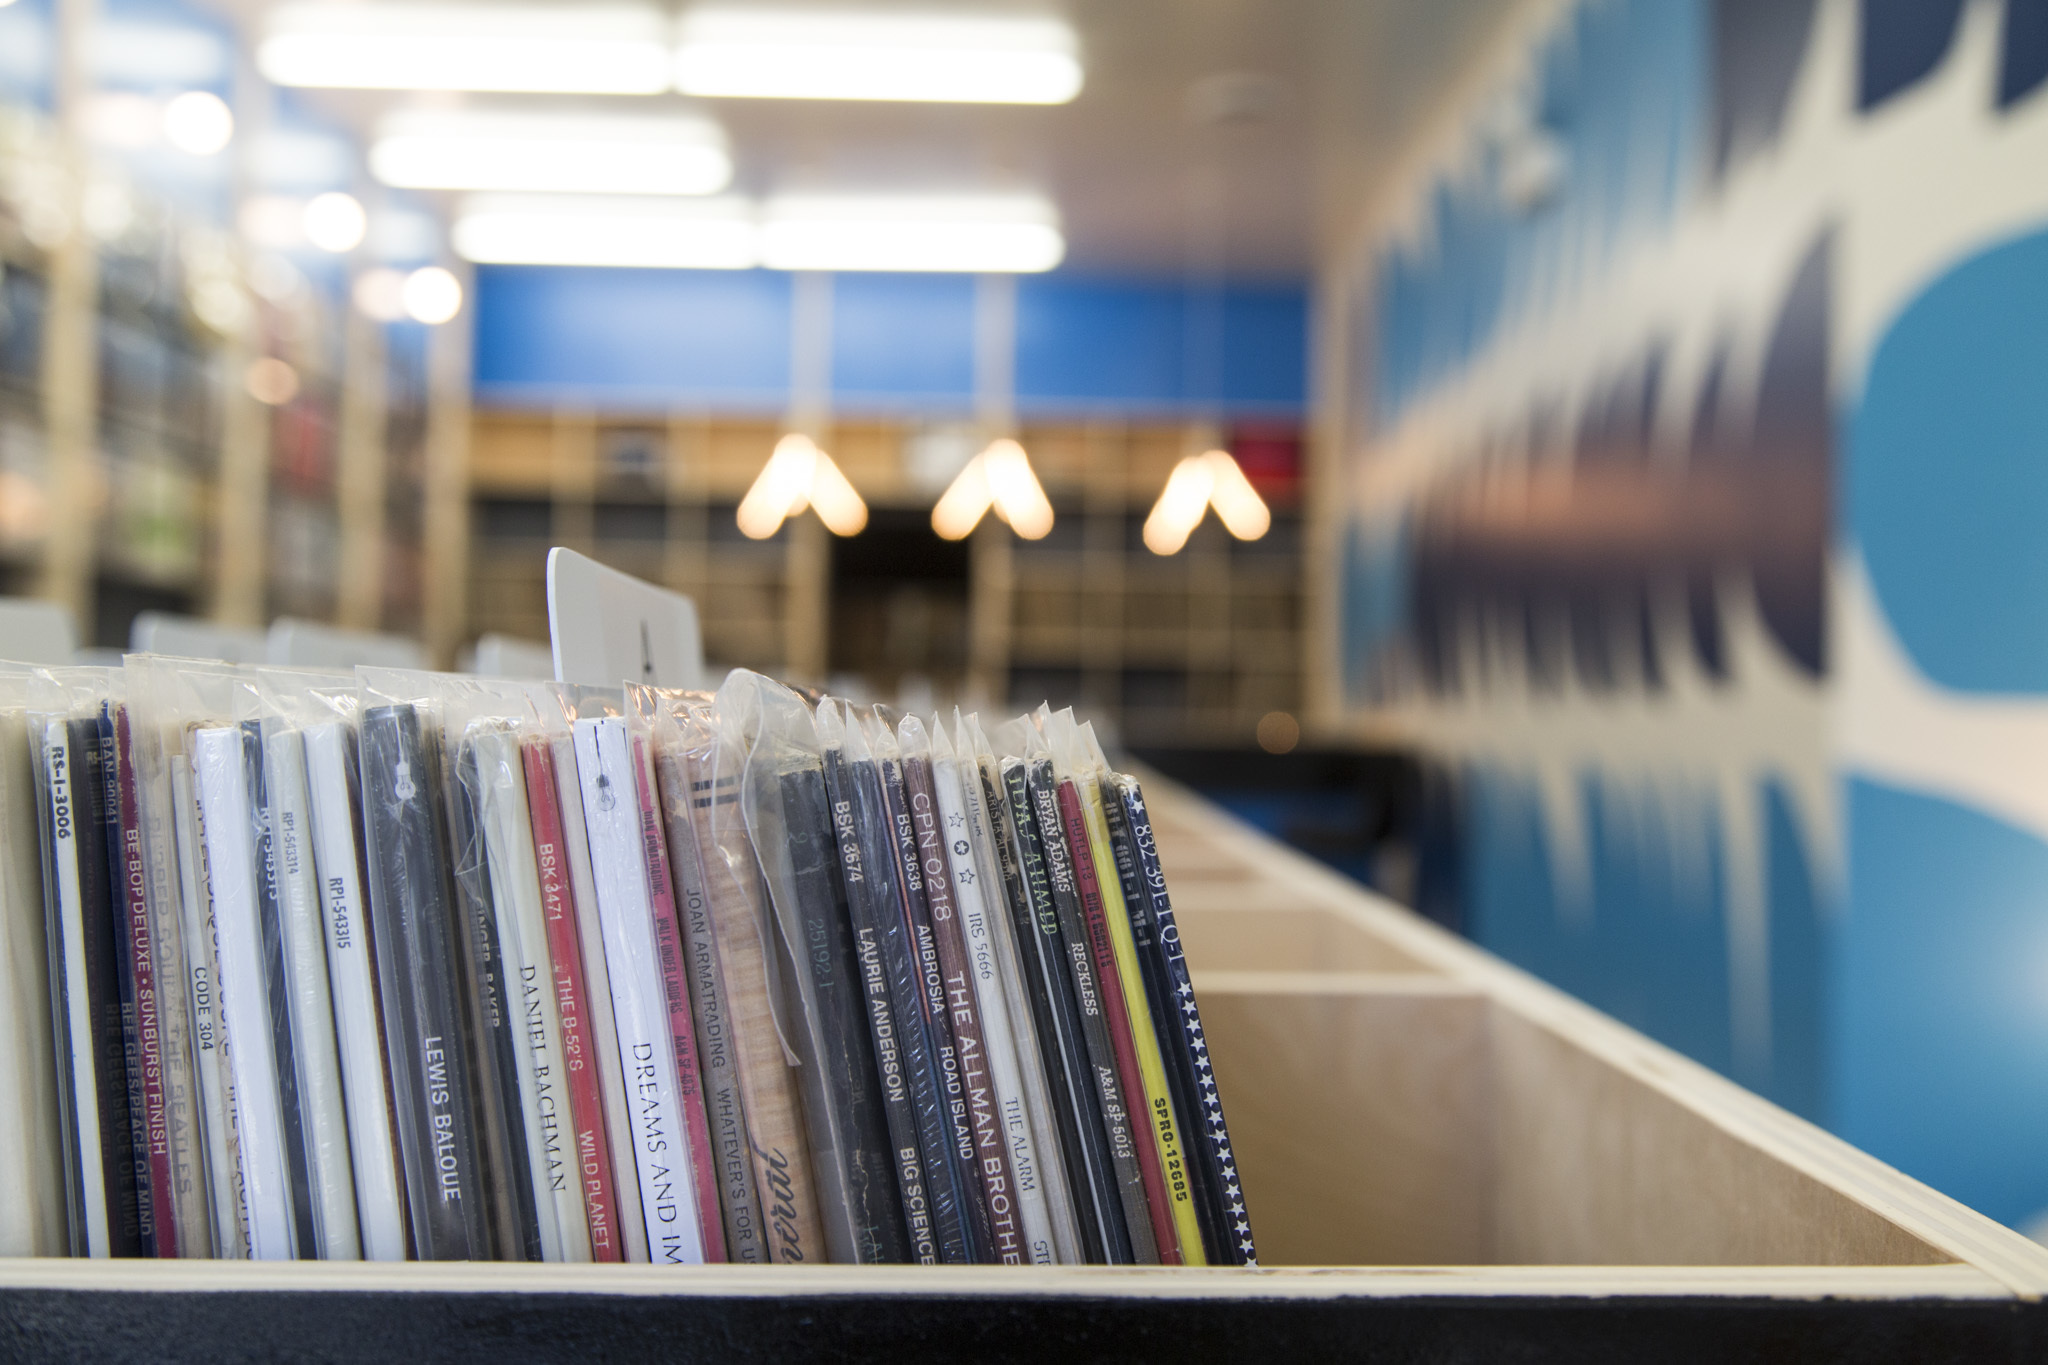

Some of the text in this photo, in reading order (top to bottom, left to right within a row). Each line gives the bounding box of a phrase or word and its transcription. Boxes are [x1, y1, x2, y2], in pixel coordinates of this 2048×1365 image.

[282, 812, 299, 874] RP1-543314
[913, 793, 938, 848] CPN
[329, 877, 351, 949] RP1-543315
[687, 889, 706, 933] JOAN
[968, 912, 985, 939] IRS
[1025, 852, 1058, 935] AHMED
[660, 943, 675, 972] UNDER
[976, 943, 995, 981] 5666
[1036, 789, 1059, 838] BRYAN
[1049, 841, 1071, 893] ADAMS
[1071, 942, 1098, 1016] RECKLESS
[1099, 1066, 1117, 1101] A&M
[126, 829, 167, 1156] BE-BOP DELUXE SUNBURST FINISH
[195, 967, 211, 1015] CODE
[663, 973, 683, 1014] LADDERS
[694, 942, 725, 1069] ARMATRADING
[897, 814, 974, 1160] BSK 3638 AMBROSIA ROAD ISLAND
[199, 1022, 214, 1051] 304
[539, 844, 609, 1249] BSK 3471 THE B-52'S WILD PLANET
[835, 801, 936, 1265] BSK 3674 LAURIE ANDERSON BIG SCIENCE
[520, 966, 566, 1192] DANIEL BACHMAN
[1005, 1097, 1023, 1131] THE
[425, 1036, 462, 1202] LEWIS BALOUE
[633, 1043, 668, 1153] DREAMS
[651, 1164, 678, 1223] AND
[717, 1088, 745, 1200] WHATEVER'S
[948, 970, 1021, 1266] THE ALLMAN BROTHE
[1154, 1097, 1188, 1202] SPRO-12685
[1013, 1134, 1036, 1192] ALARM
[735, 1206, 752, 1241] FOR
